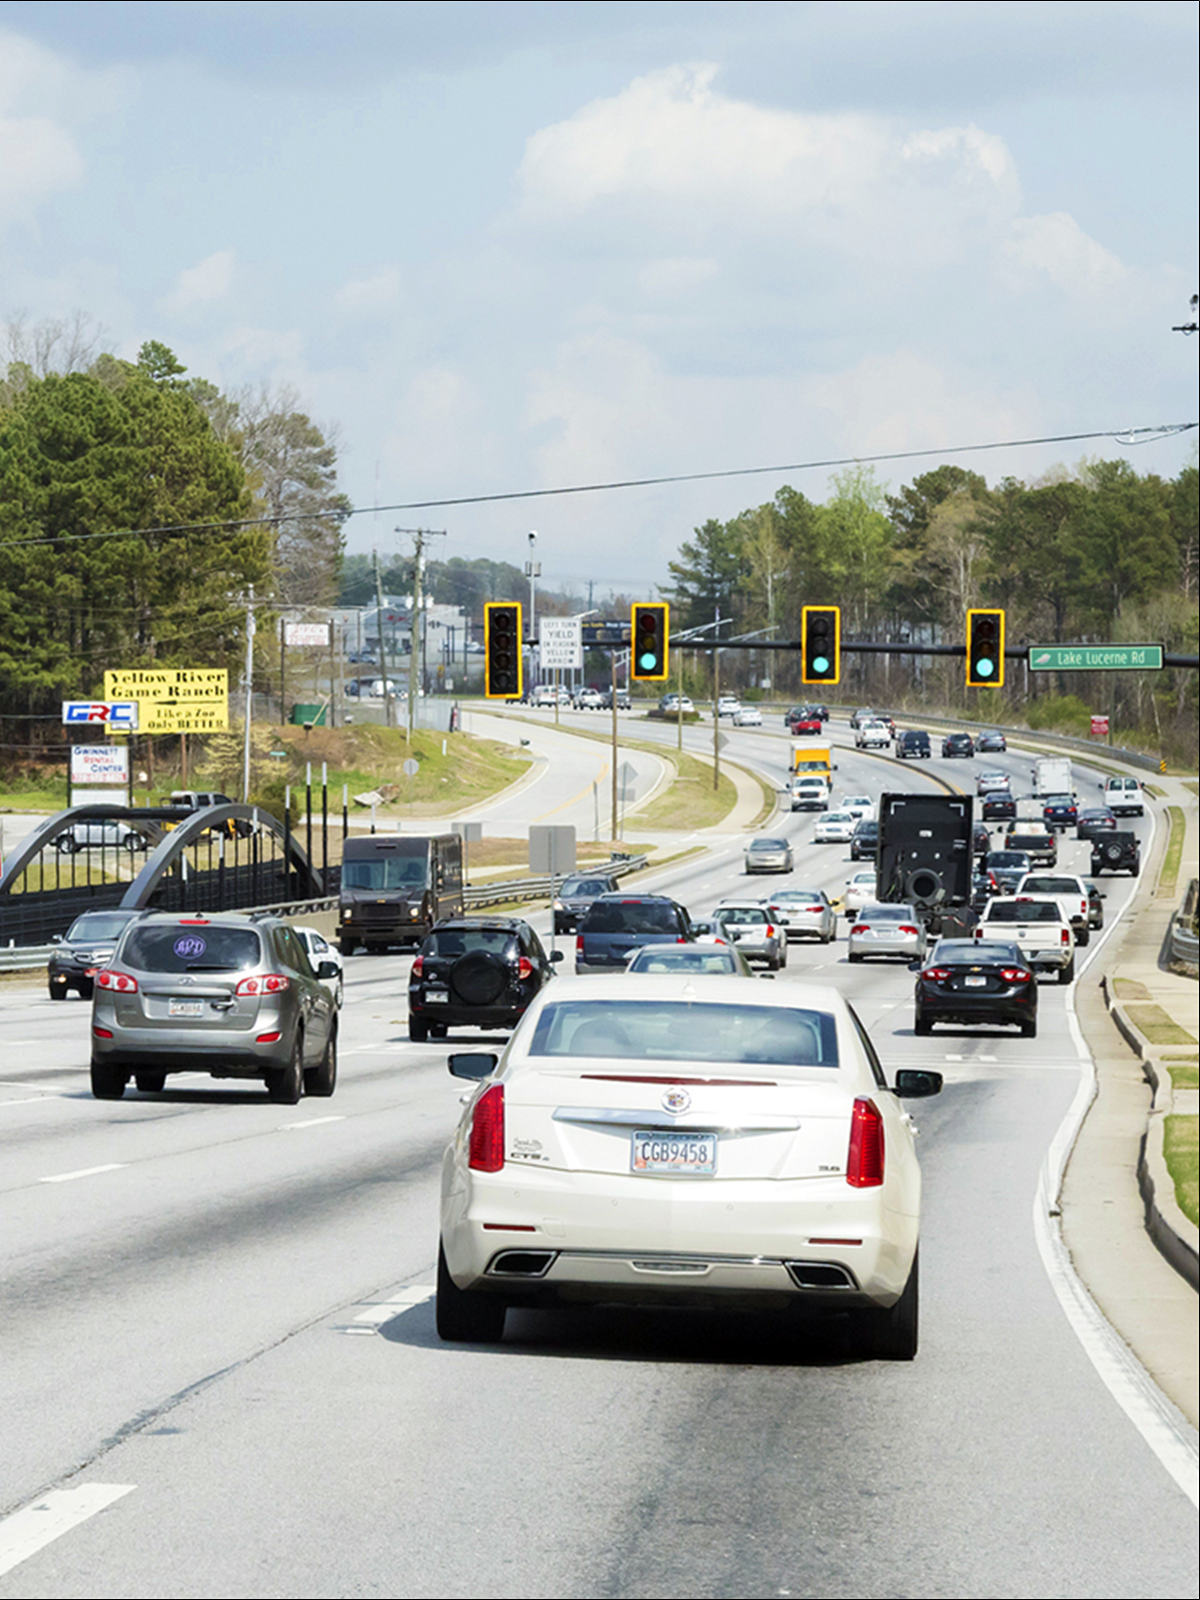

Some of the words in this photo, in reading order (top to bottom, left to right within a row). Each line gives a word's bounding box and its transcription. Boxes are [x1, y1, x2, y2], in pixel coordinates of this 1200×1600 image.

[548, 630, 573, 639] YIELD
[1057, 651, 1082, 665] Lake
[1086, 652, 1128, 665] Lucerne
[1131, 650, 1145, 664] Rd
[111, 672, 167, 683] Yellow
[176, 672, 225, 683] River
[111, 686, 162, 697] Game
[169, 685, 224, 697] Ranch
[66, 704, 131, 721] GRC
[156, 709, 183, 718] Like
[195, 708, 215, 718] Zoo
[147, 720, 172, 730] Only
[177, 720, 224, 729] BETTER
[83, 756, 115, 764] RENTAL
[90, 764, 123, 772] CENTER
[641, 1141, 708, 1164] CGB9458
